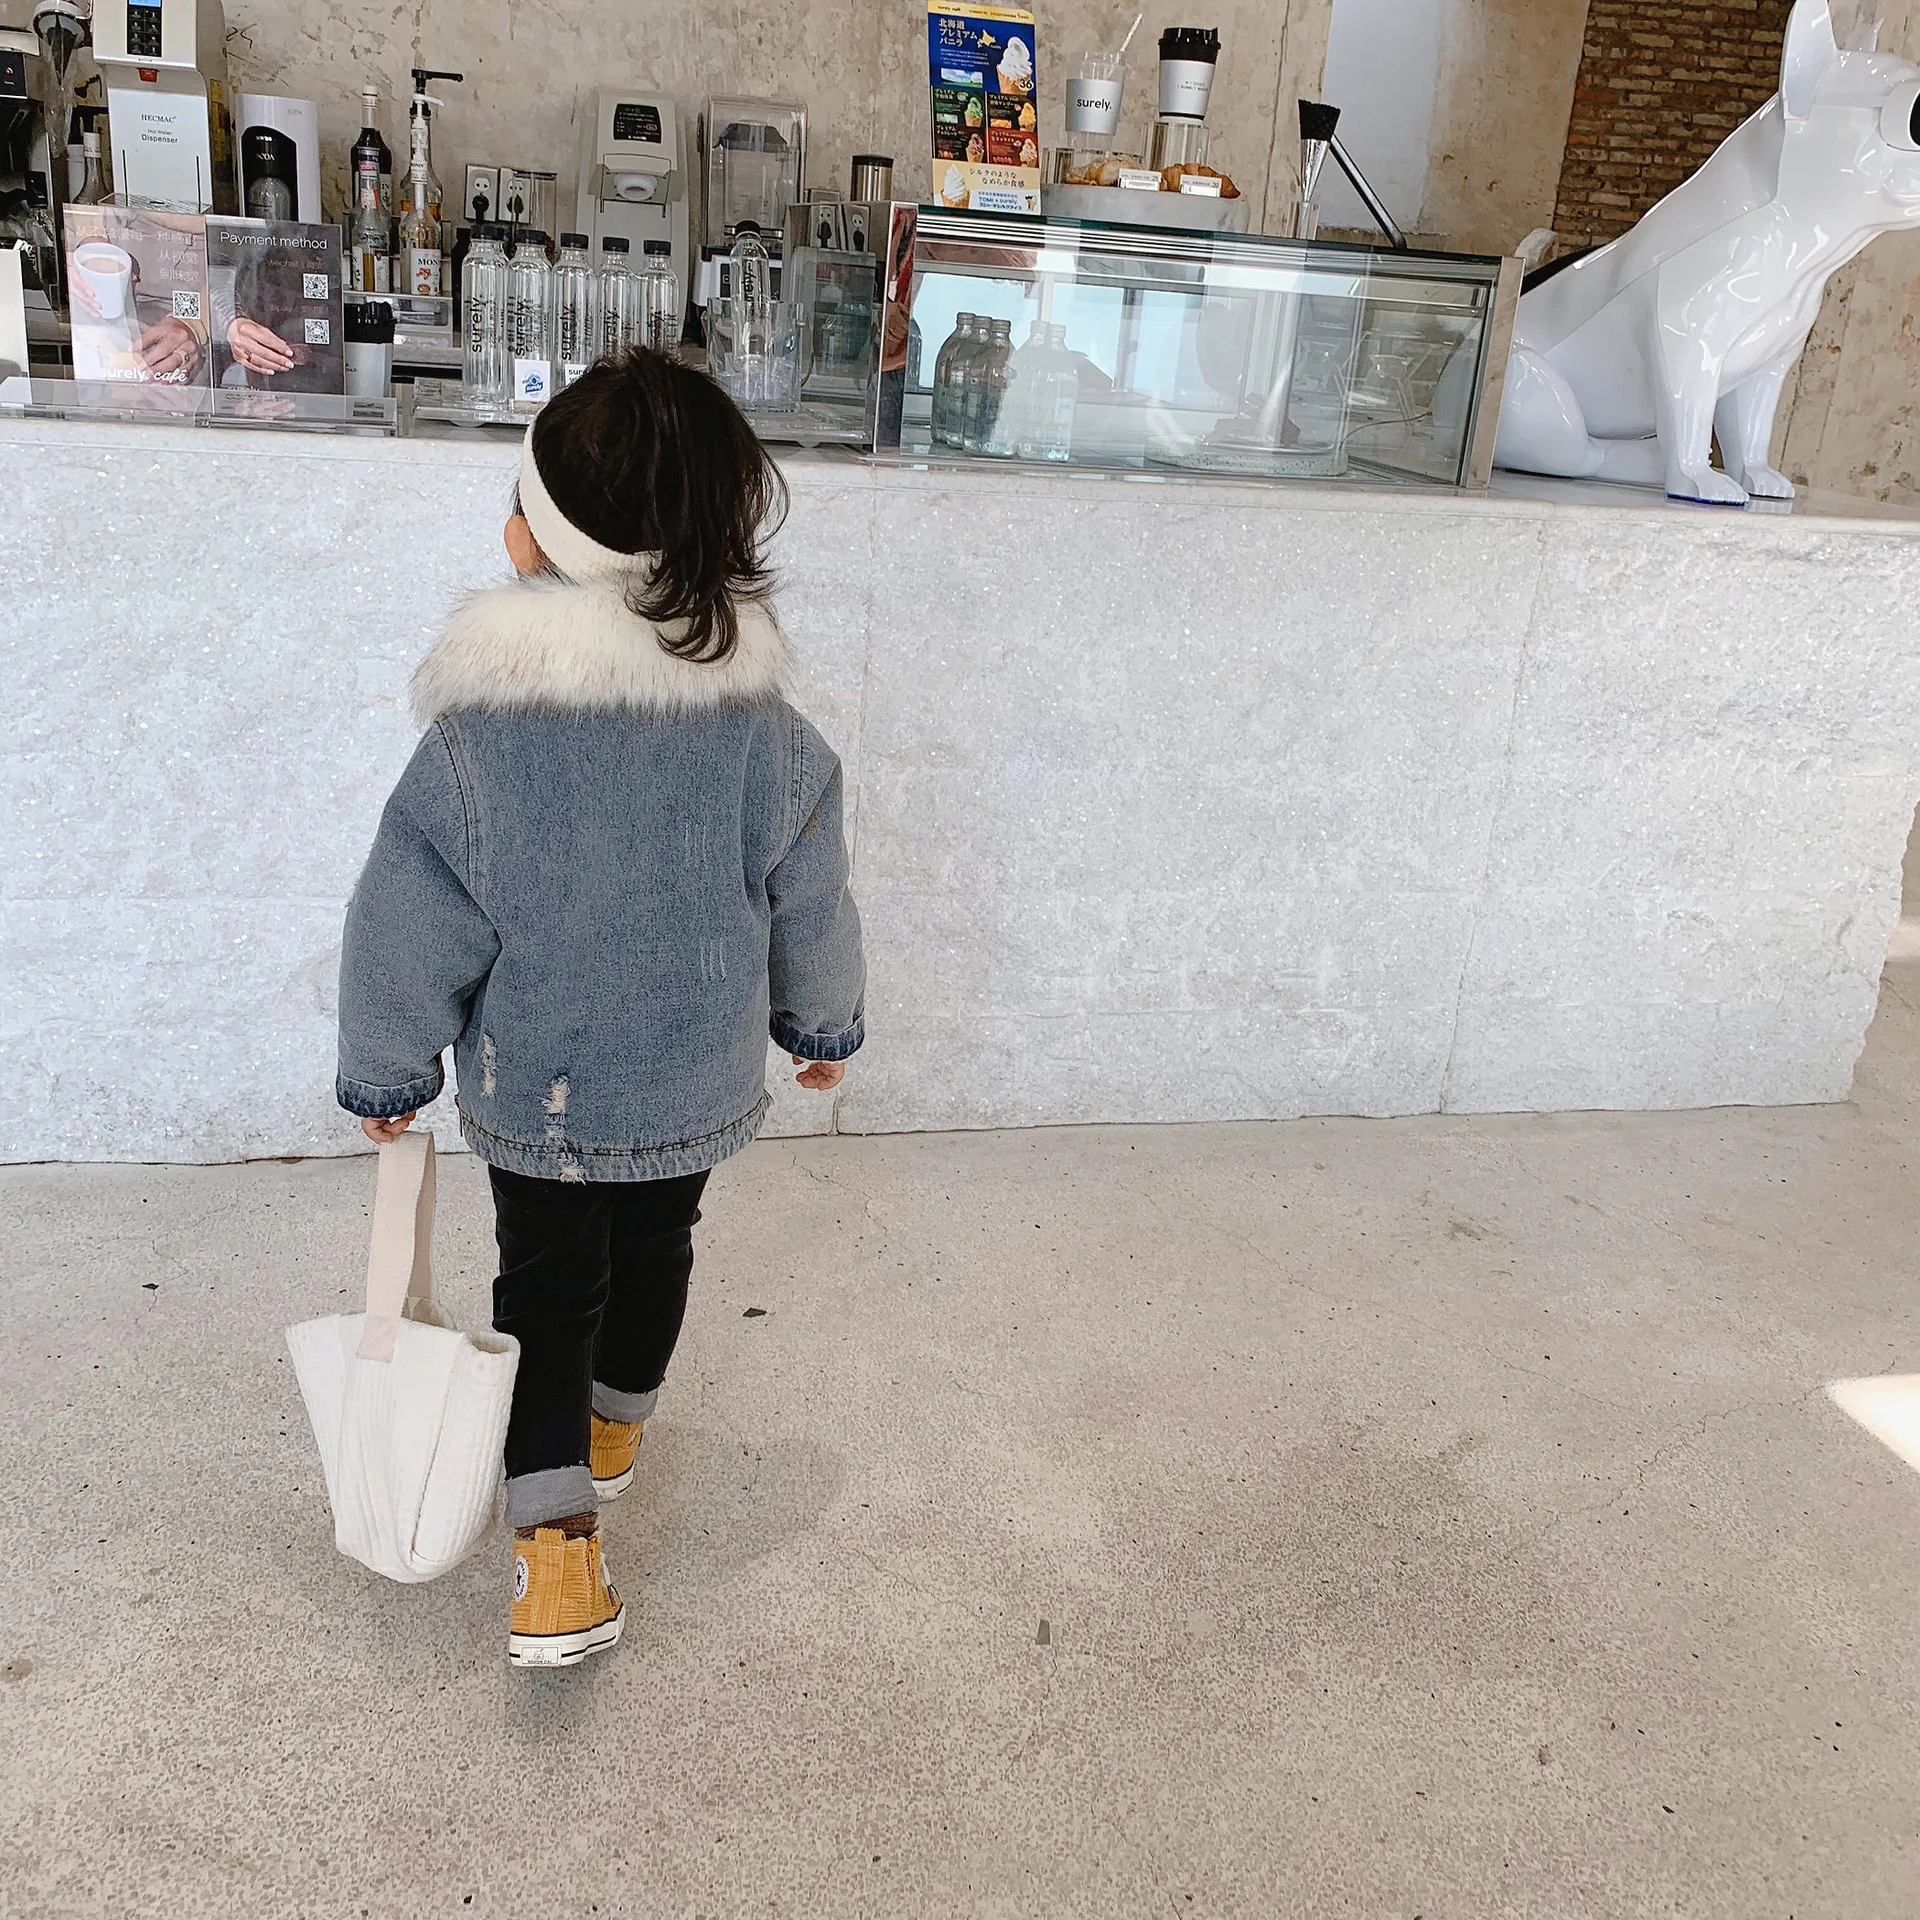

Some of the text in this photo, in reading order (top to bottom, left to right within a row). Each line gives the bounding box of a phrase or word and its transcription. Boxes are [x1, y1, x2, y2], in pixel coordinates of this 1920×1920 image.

[939, 27, 978, 40] プレミアム
[939, 36, 963, 47] バニラ
[1019, 79, 1033, 89] 36
[1076, 98, 1112, 112] surely.
[141, 134, 178, 144] Dispenser
[220, 231, 329, 250] Payment method
[469, 294, 487, 354] surely.
[153, 368, 188, 384] café
